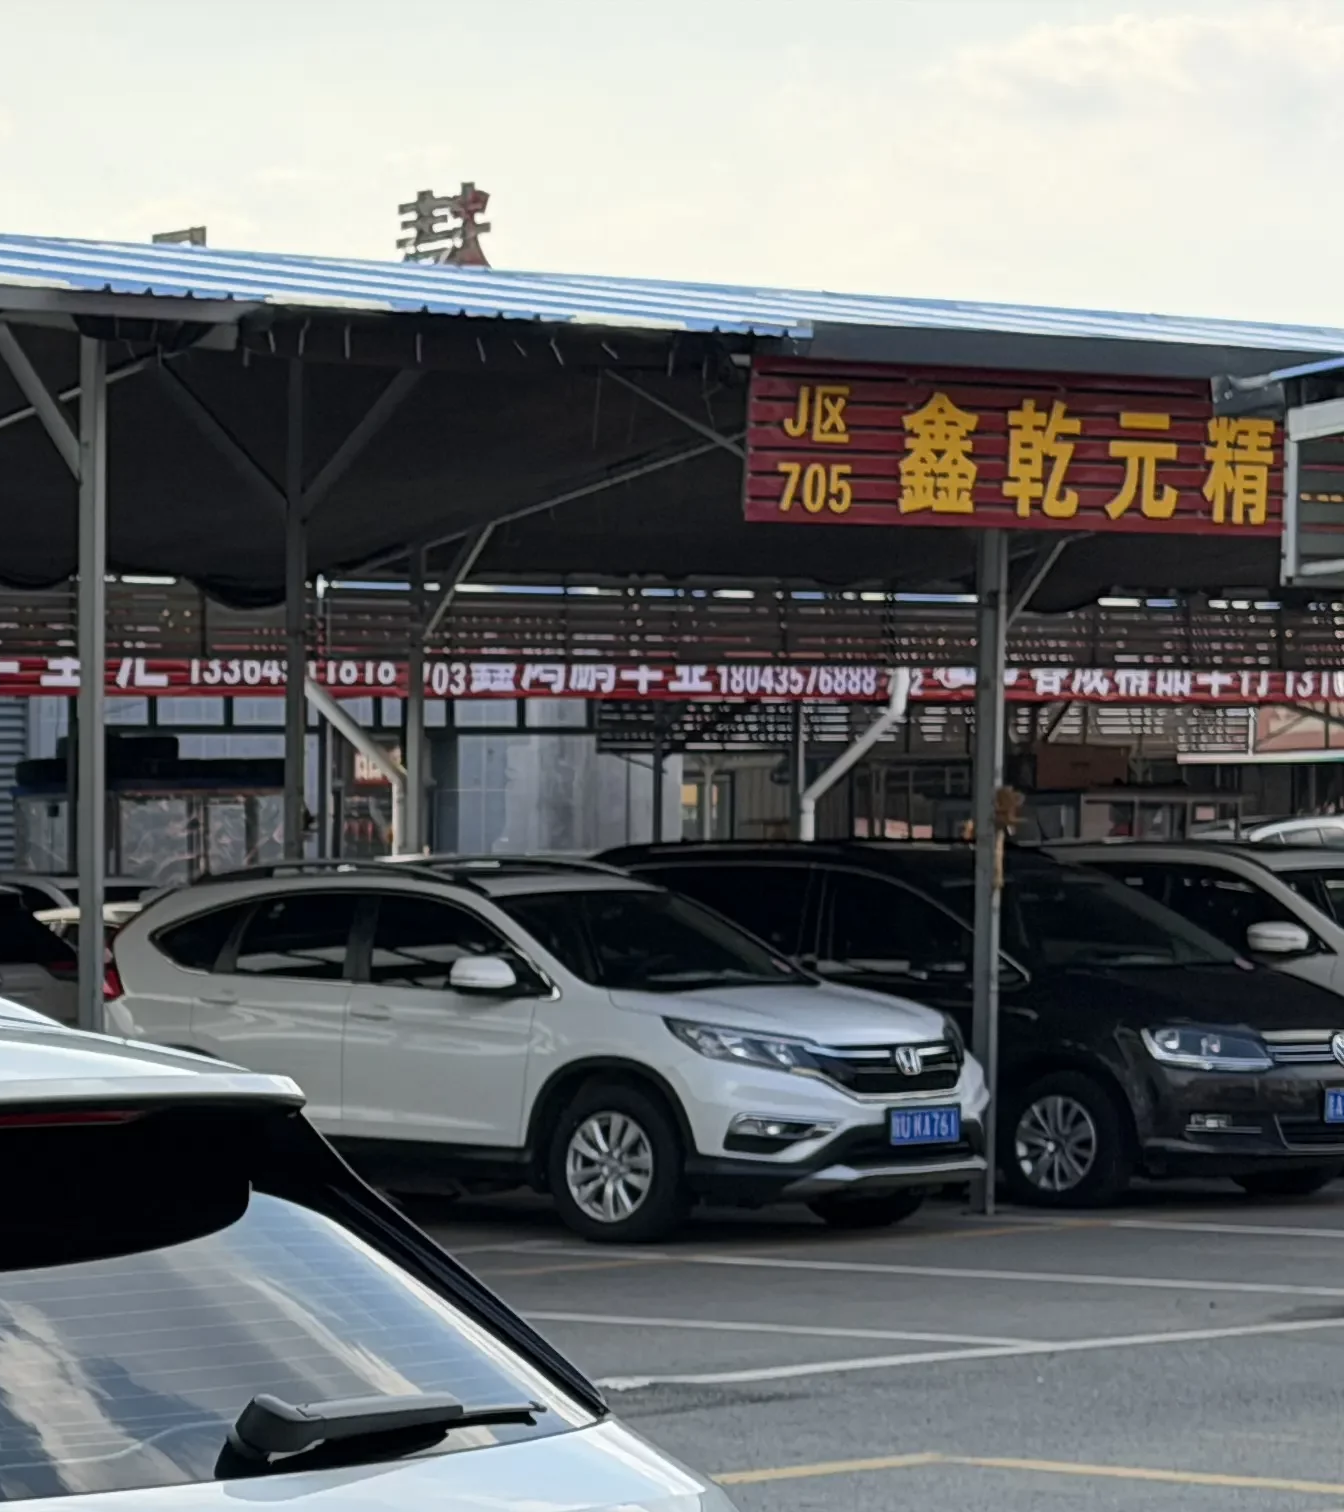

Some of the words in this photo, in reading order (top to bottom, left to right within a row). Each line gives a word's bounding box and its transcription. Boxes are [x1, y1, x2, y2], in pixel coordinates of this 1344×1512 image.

[783, 384, 850, 444] J区
[777, 461, 852, 515] 705
[897, 391, 1277, 526] 鑫乾元精
